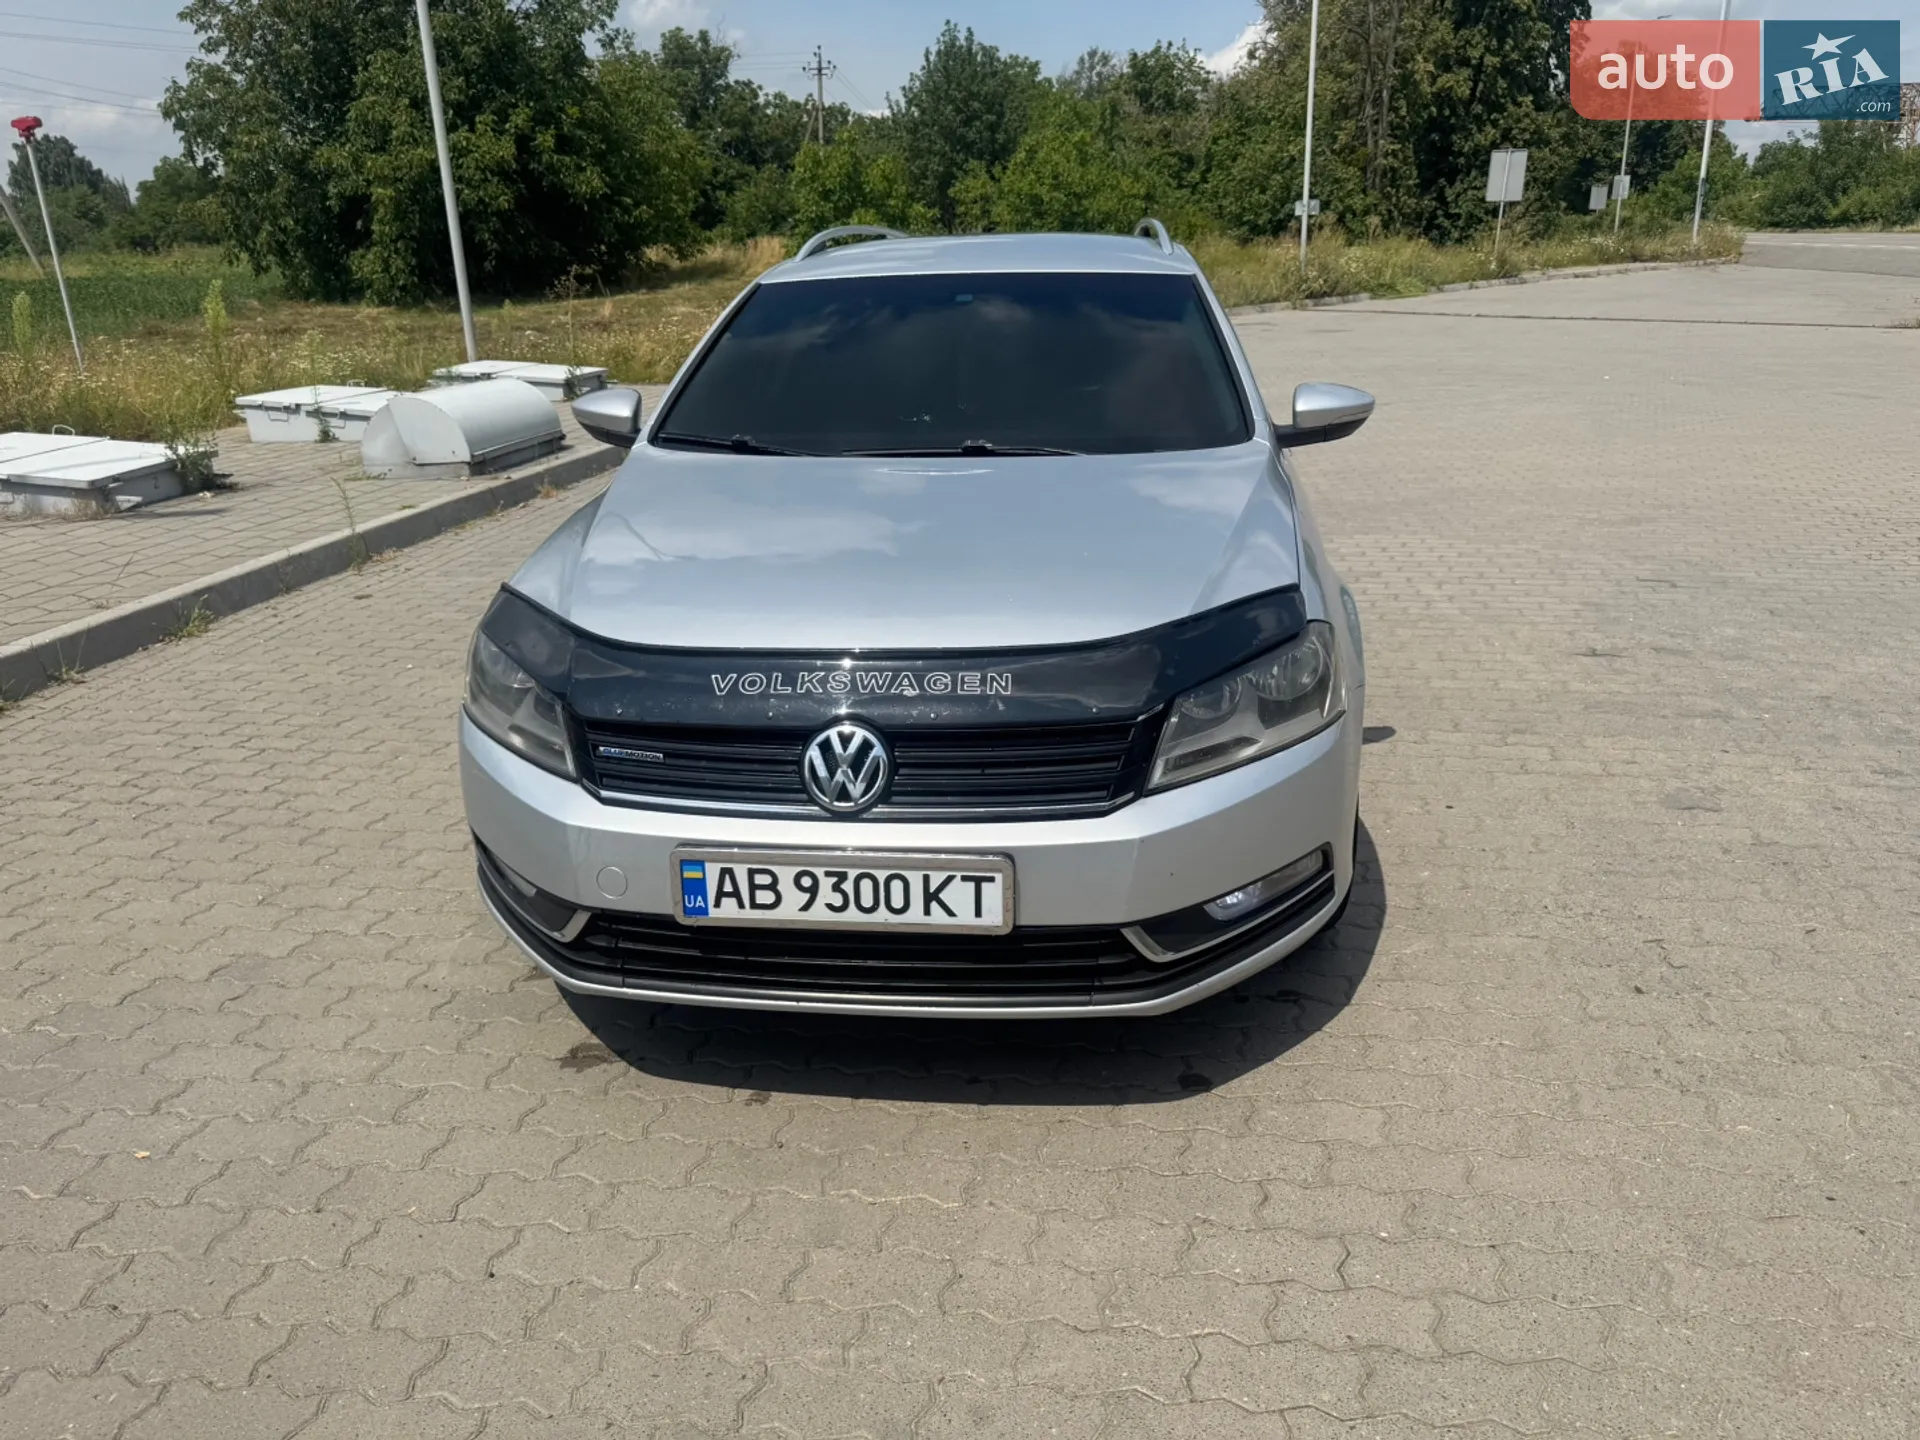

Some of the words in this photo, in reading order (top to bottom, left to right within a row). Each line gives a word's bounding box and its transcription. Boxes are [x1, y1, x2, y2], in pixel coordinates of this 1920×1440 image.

[711, 671, 1012, 696] VOLKSWAGEN
[684, 894, 706, 908] UA
[713, 866, 783, 911] AB
[793, 869, 911, 915] 9300
[922, 873, 996, 918] KT
